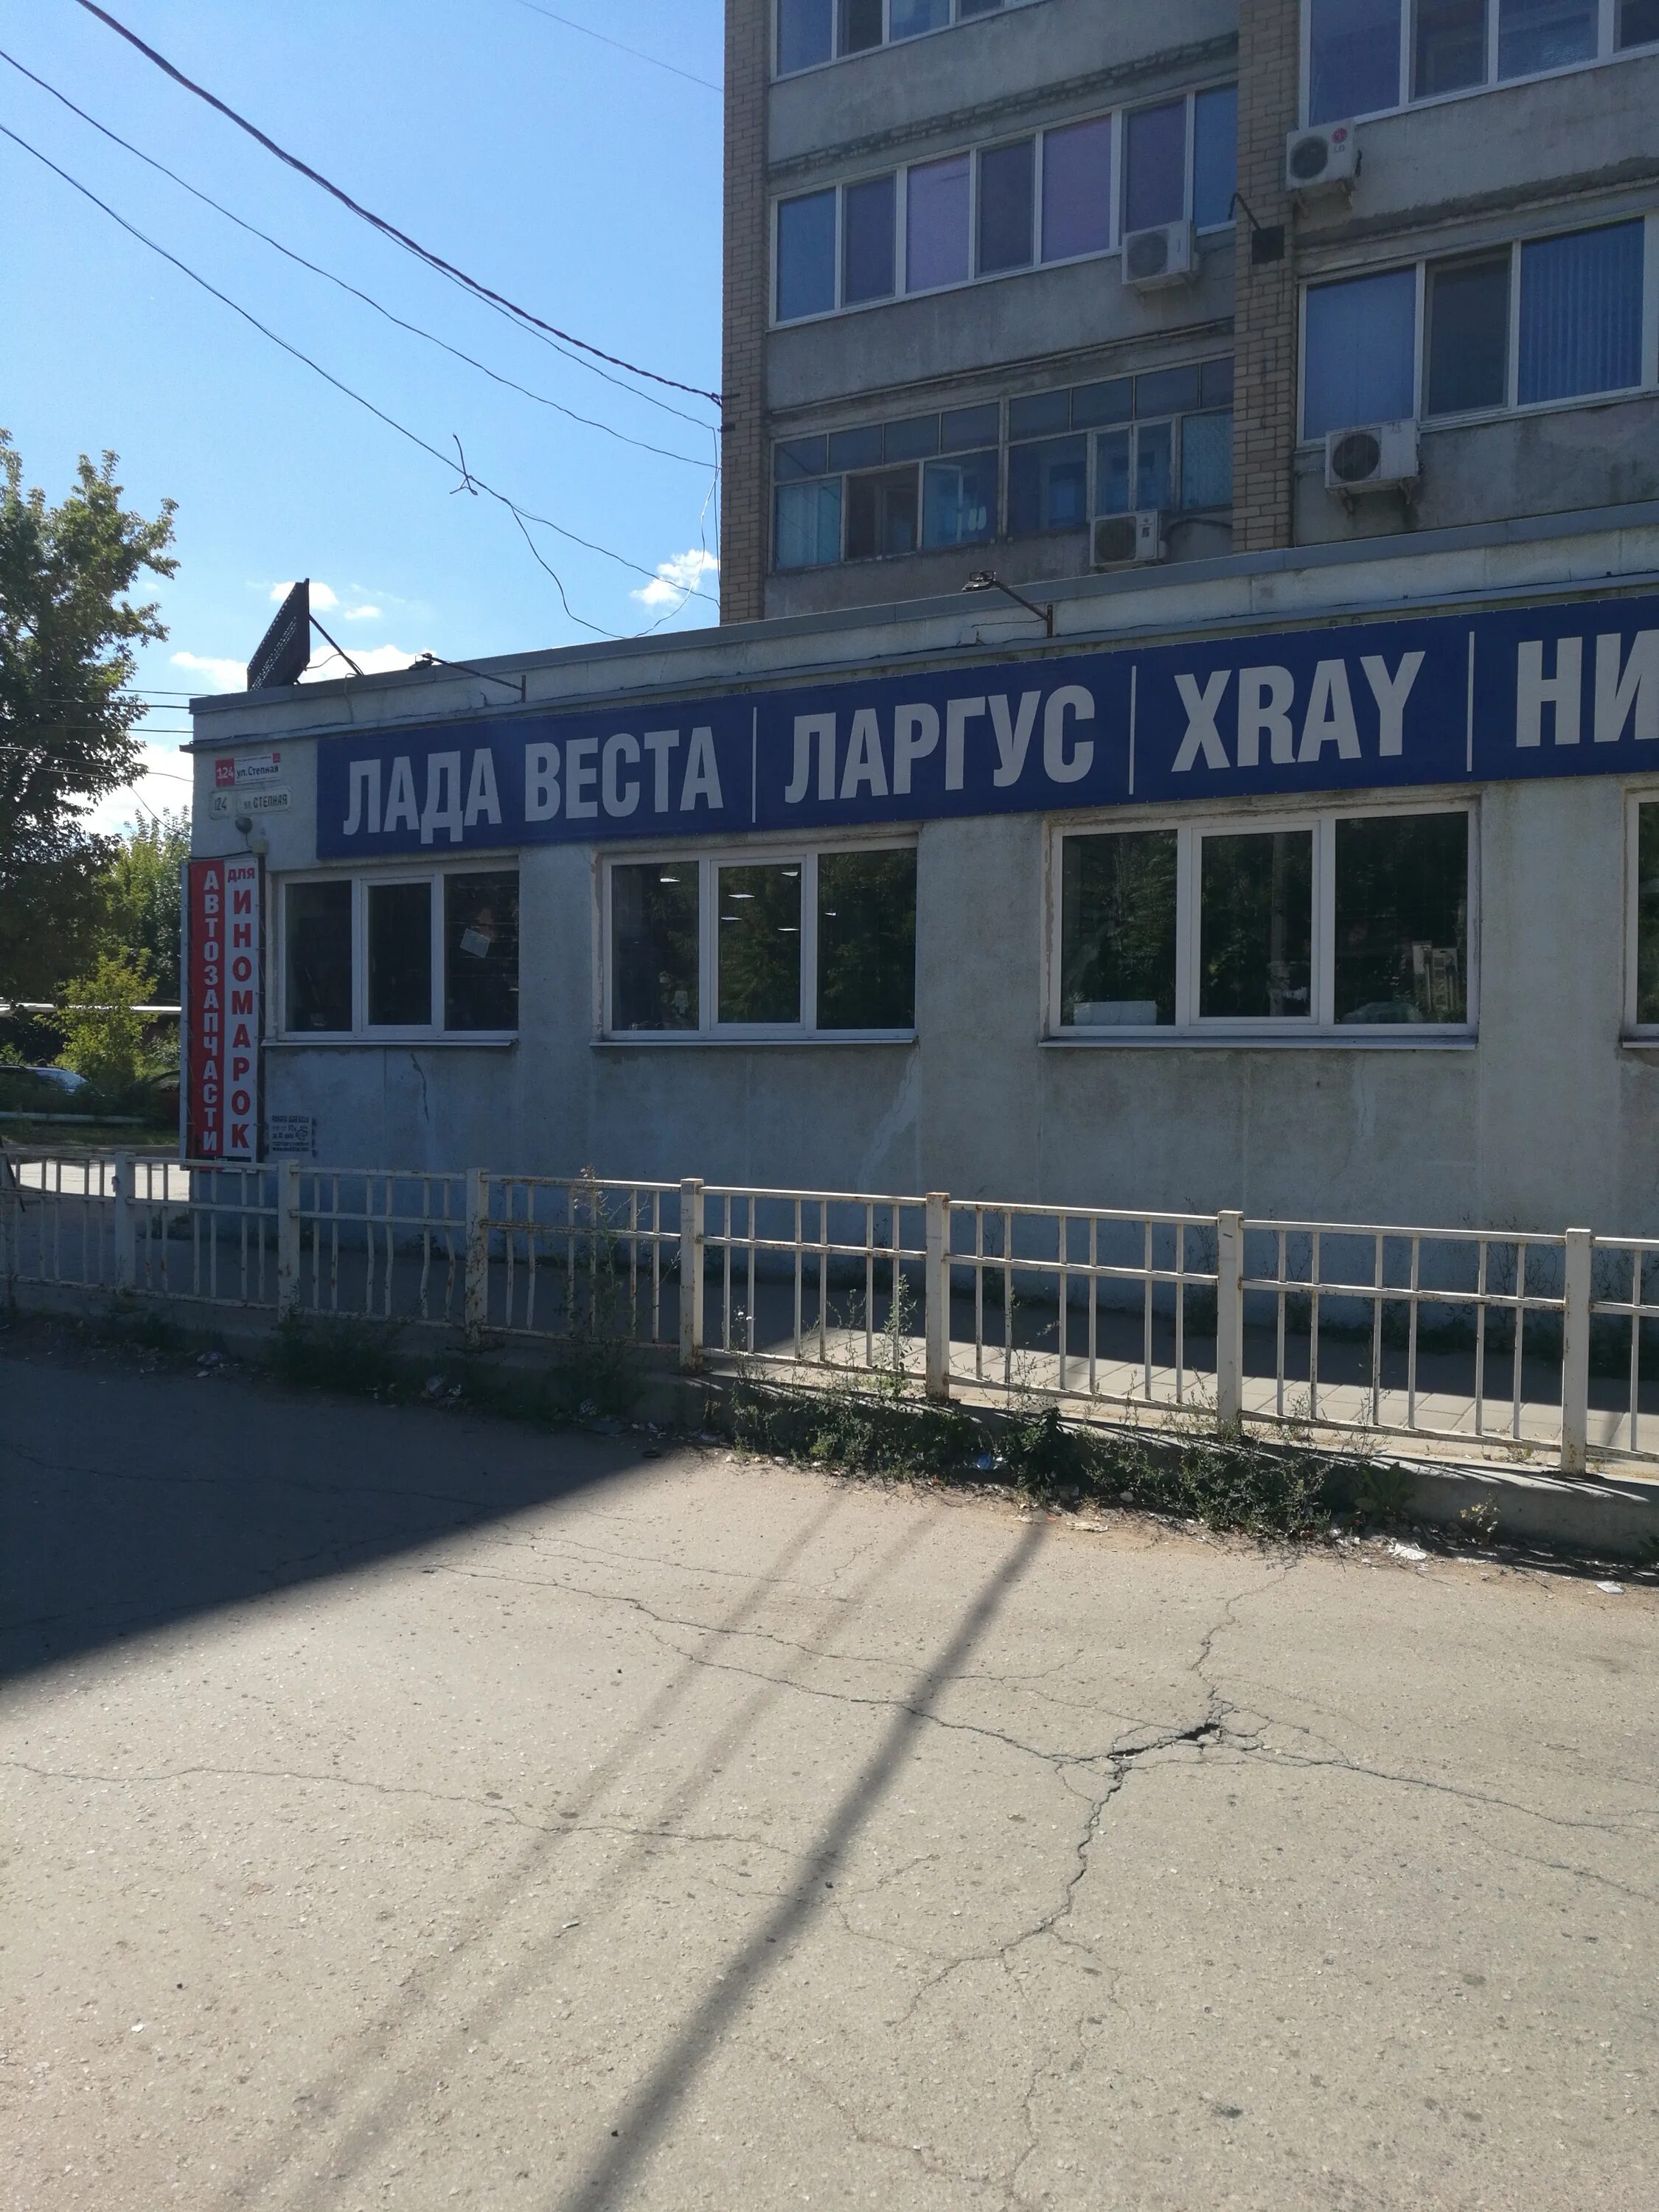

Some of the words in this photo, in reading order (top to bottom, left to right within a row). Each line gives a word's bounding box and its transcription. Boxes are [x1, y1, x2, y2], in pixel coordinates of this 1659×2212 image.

[785, 685, 1096, 804] ЛАРГУС
[1171, 651, 1426, 773] XRAY
[214, 797, 227, 810] 124
[253, 794, 288, 808] СТЕПНАЯ
[216, 767, 234, 779] 124
[343, 748, 502, 845] ЛАДА
[525, 726, 723, 822] ВЕСТА
[203, 869, 219, 1151] АВТОЗАПЧАСТИ
[232, 889, 252, 1149] ИНОМАРОК
